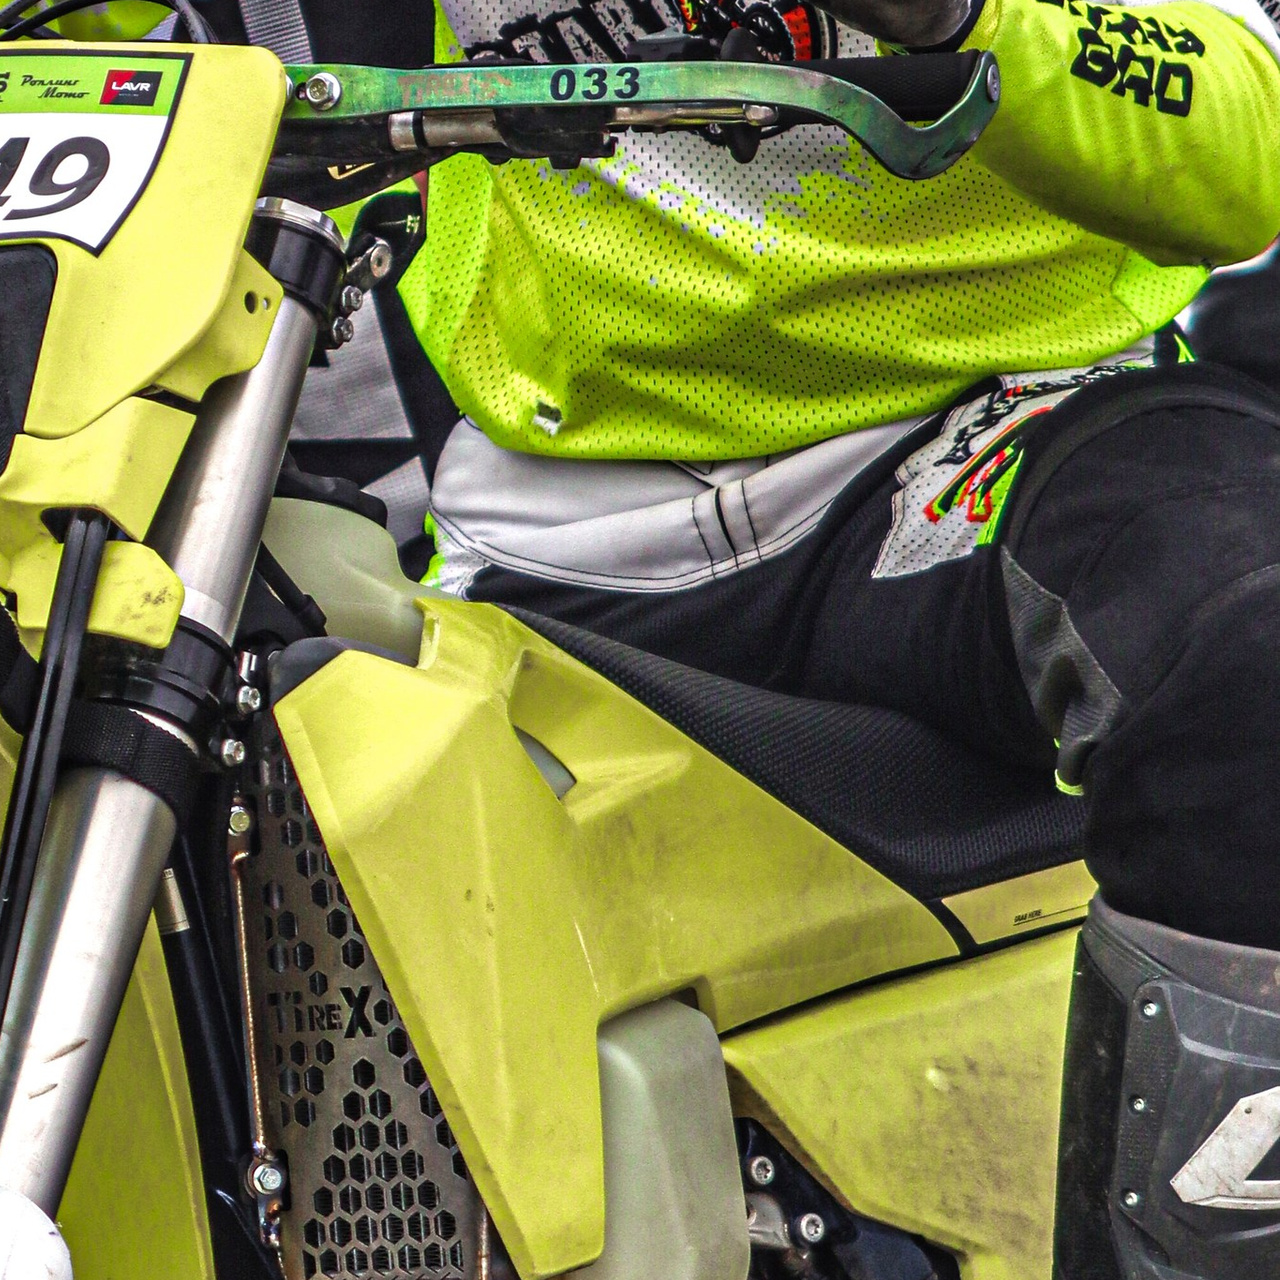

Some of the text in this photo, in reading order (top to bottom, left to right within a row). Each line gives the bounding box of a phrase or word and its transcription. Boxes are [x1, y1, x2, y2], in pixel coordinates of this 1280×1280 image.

[111, 81, 152, 92] LAVR
[549, 66, 641, 101] 033
[1070, 27, 1193, 118] BRO
